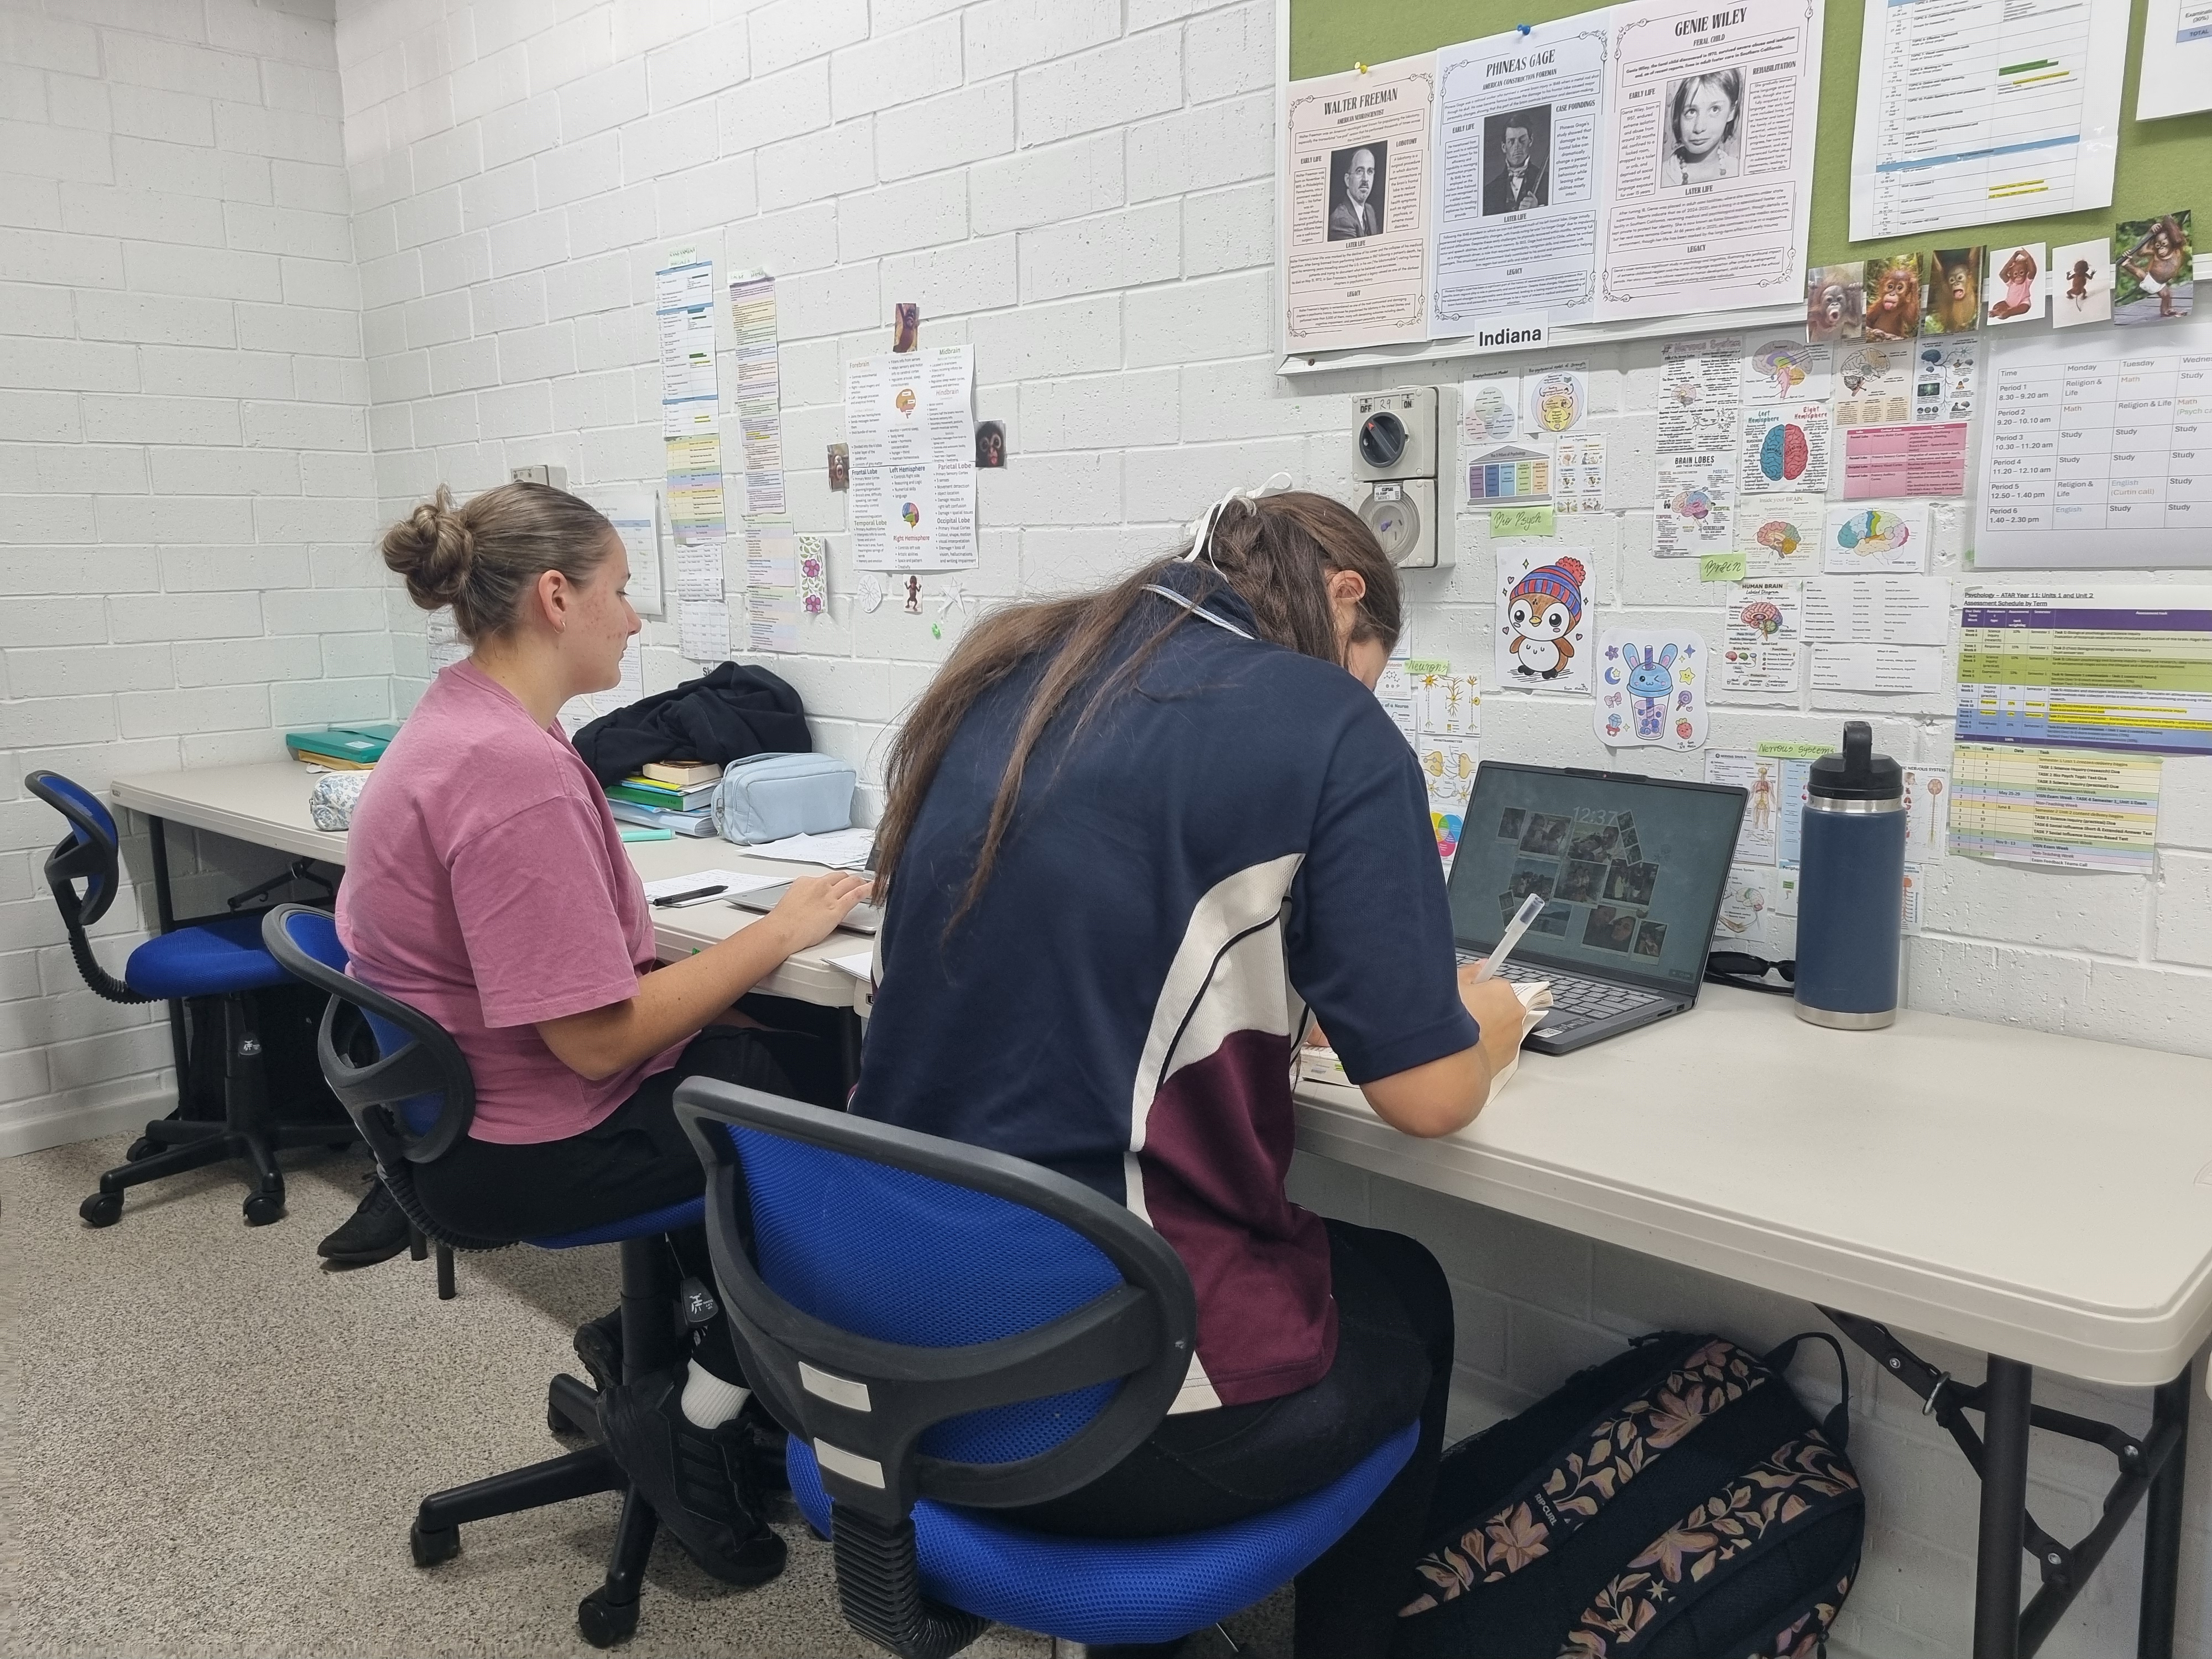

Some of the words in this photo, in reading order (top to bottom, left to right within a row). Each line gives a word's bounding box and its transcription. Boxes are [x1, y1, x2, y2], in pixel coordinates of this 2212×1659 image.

[1675, 15, 1708, 36] GENIE
[1712, 7, 1747, 30] WILEY
[1693, 36, 1709, 46] FERAL
[1710, 34, 1725, 44] CHILD
[1486, 57, 1527, 77] PHINEAS
[1529, 49, 1556, 67] GAGE
[1753, 61, 1796, 75] REHABILITATION
[1482, 80, 1503, 90] AMERICAN
[1504, 74, 1535, 85] CONSTRUCTION
[1536, 68, 1557, 79] FOREMAN
[1324, 97, 1357, 115] WALTER
[1360, 88, 1398, 108] FREEMAN
[1629, 90, 1644, 99] EARLY
[1556, 104, 1567, 112] CASE
[1568, 100, 1595, 110] FOUNDINGS
[1337, 115, 1354, 124] AMERICAN
[1355, 109, 1384, 122] NEUROSCIENTIST
[1396, 138, 1417, 147] LOBOTOMY
[1686, 187, 1701, 196] LATER
[1688, 244, 1706, 253] LEGACY
[1479, 328, 1541, 347] Indiana
[1380, 399, 1391, 409] R9
[1515, 511, 1541, 531] Psych
[1704, 560, 1741, 577] Brain
[1408, 660, 1448, 672] Neurons
[1759, 744, 1793, 753] Nervous
[1798, 745, 1834, 757] systems
[1574, 806, 1618, 825] 12:37
